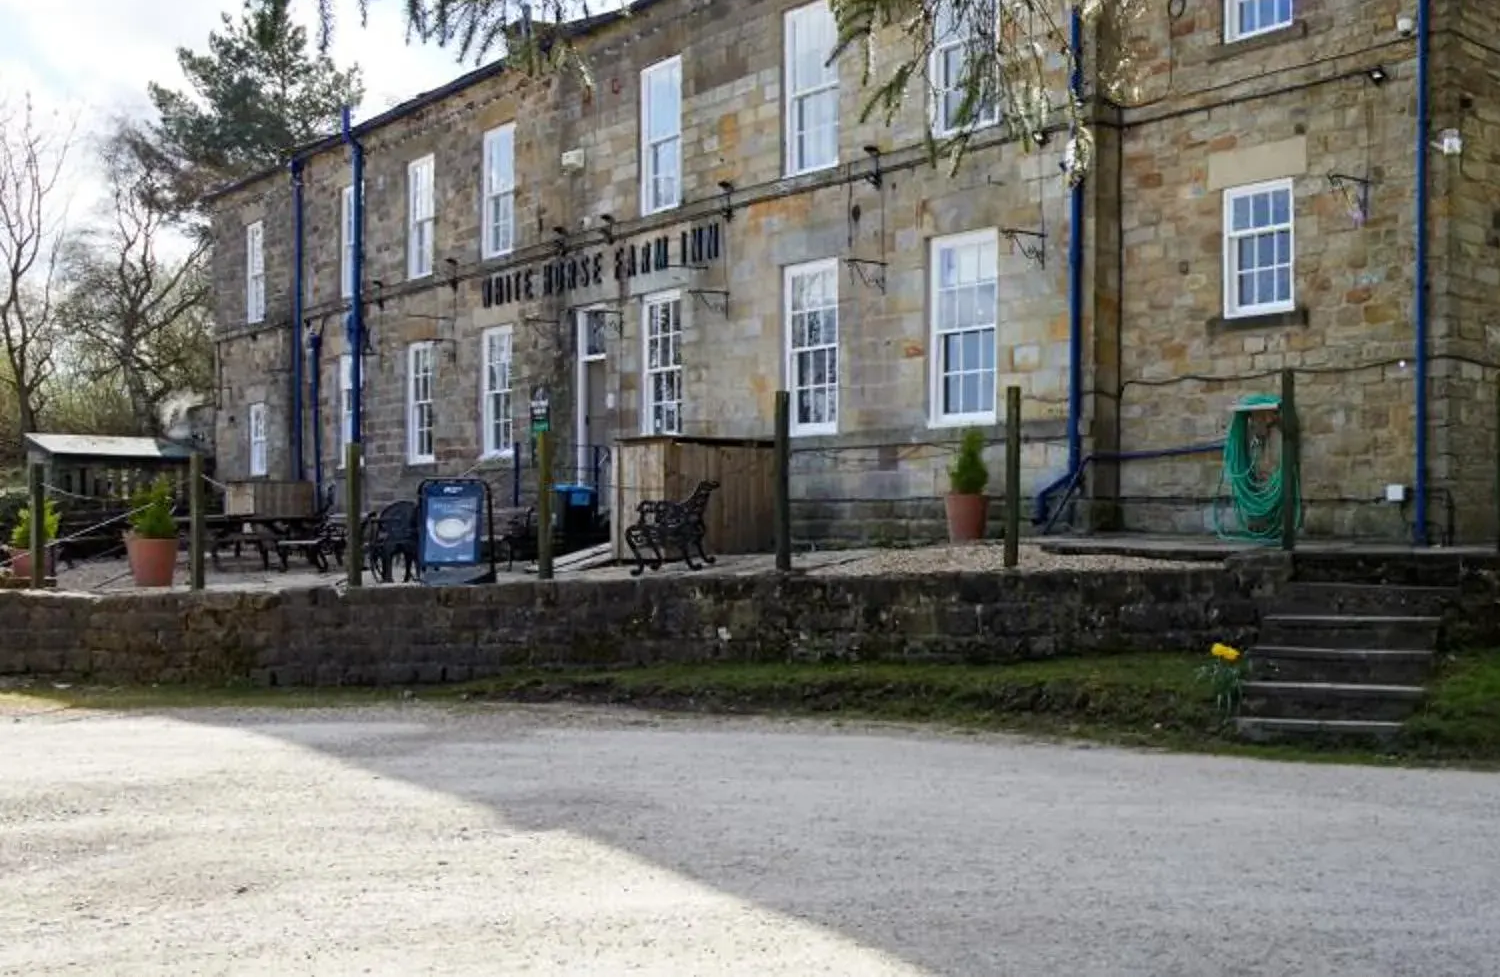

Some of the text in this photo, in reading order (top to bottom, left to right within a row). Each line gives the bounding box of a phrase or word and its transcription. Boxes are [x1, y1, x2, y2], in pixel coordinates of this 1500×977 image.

[482, 222, 719, 308] WHITE HORSE FARM INN
